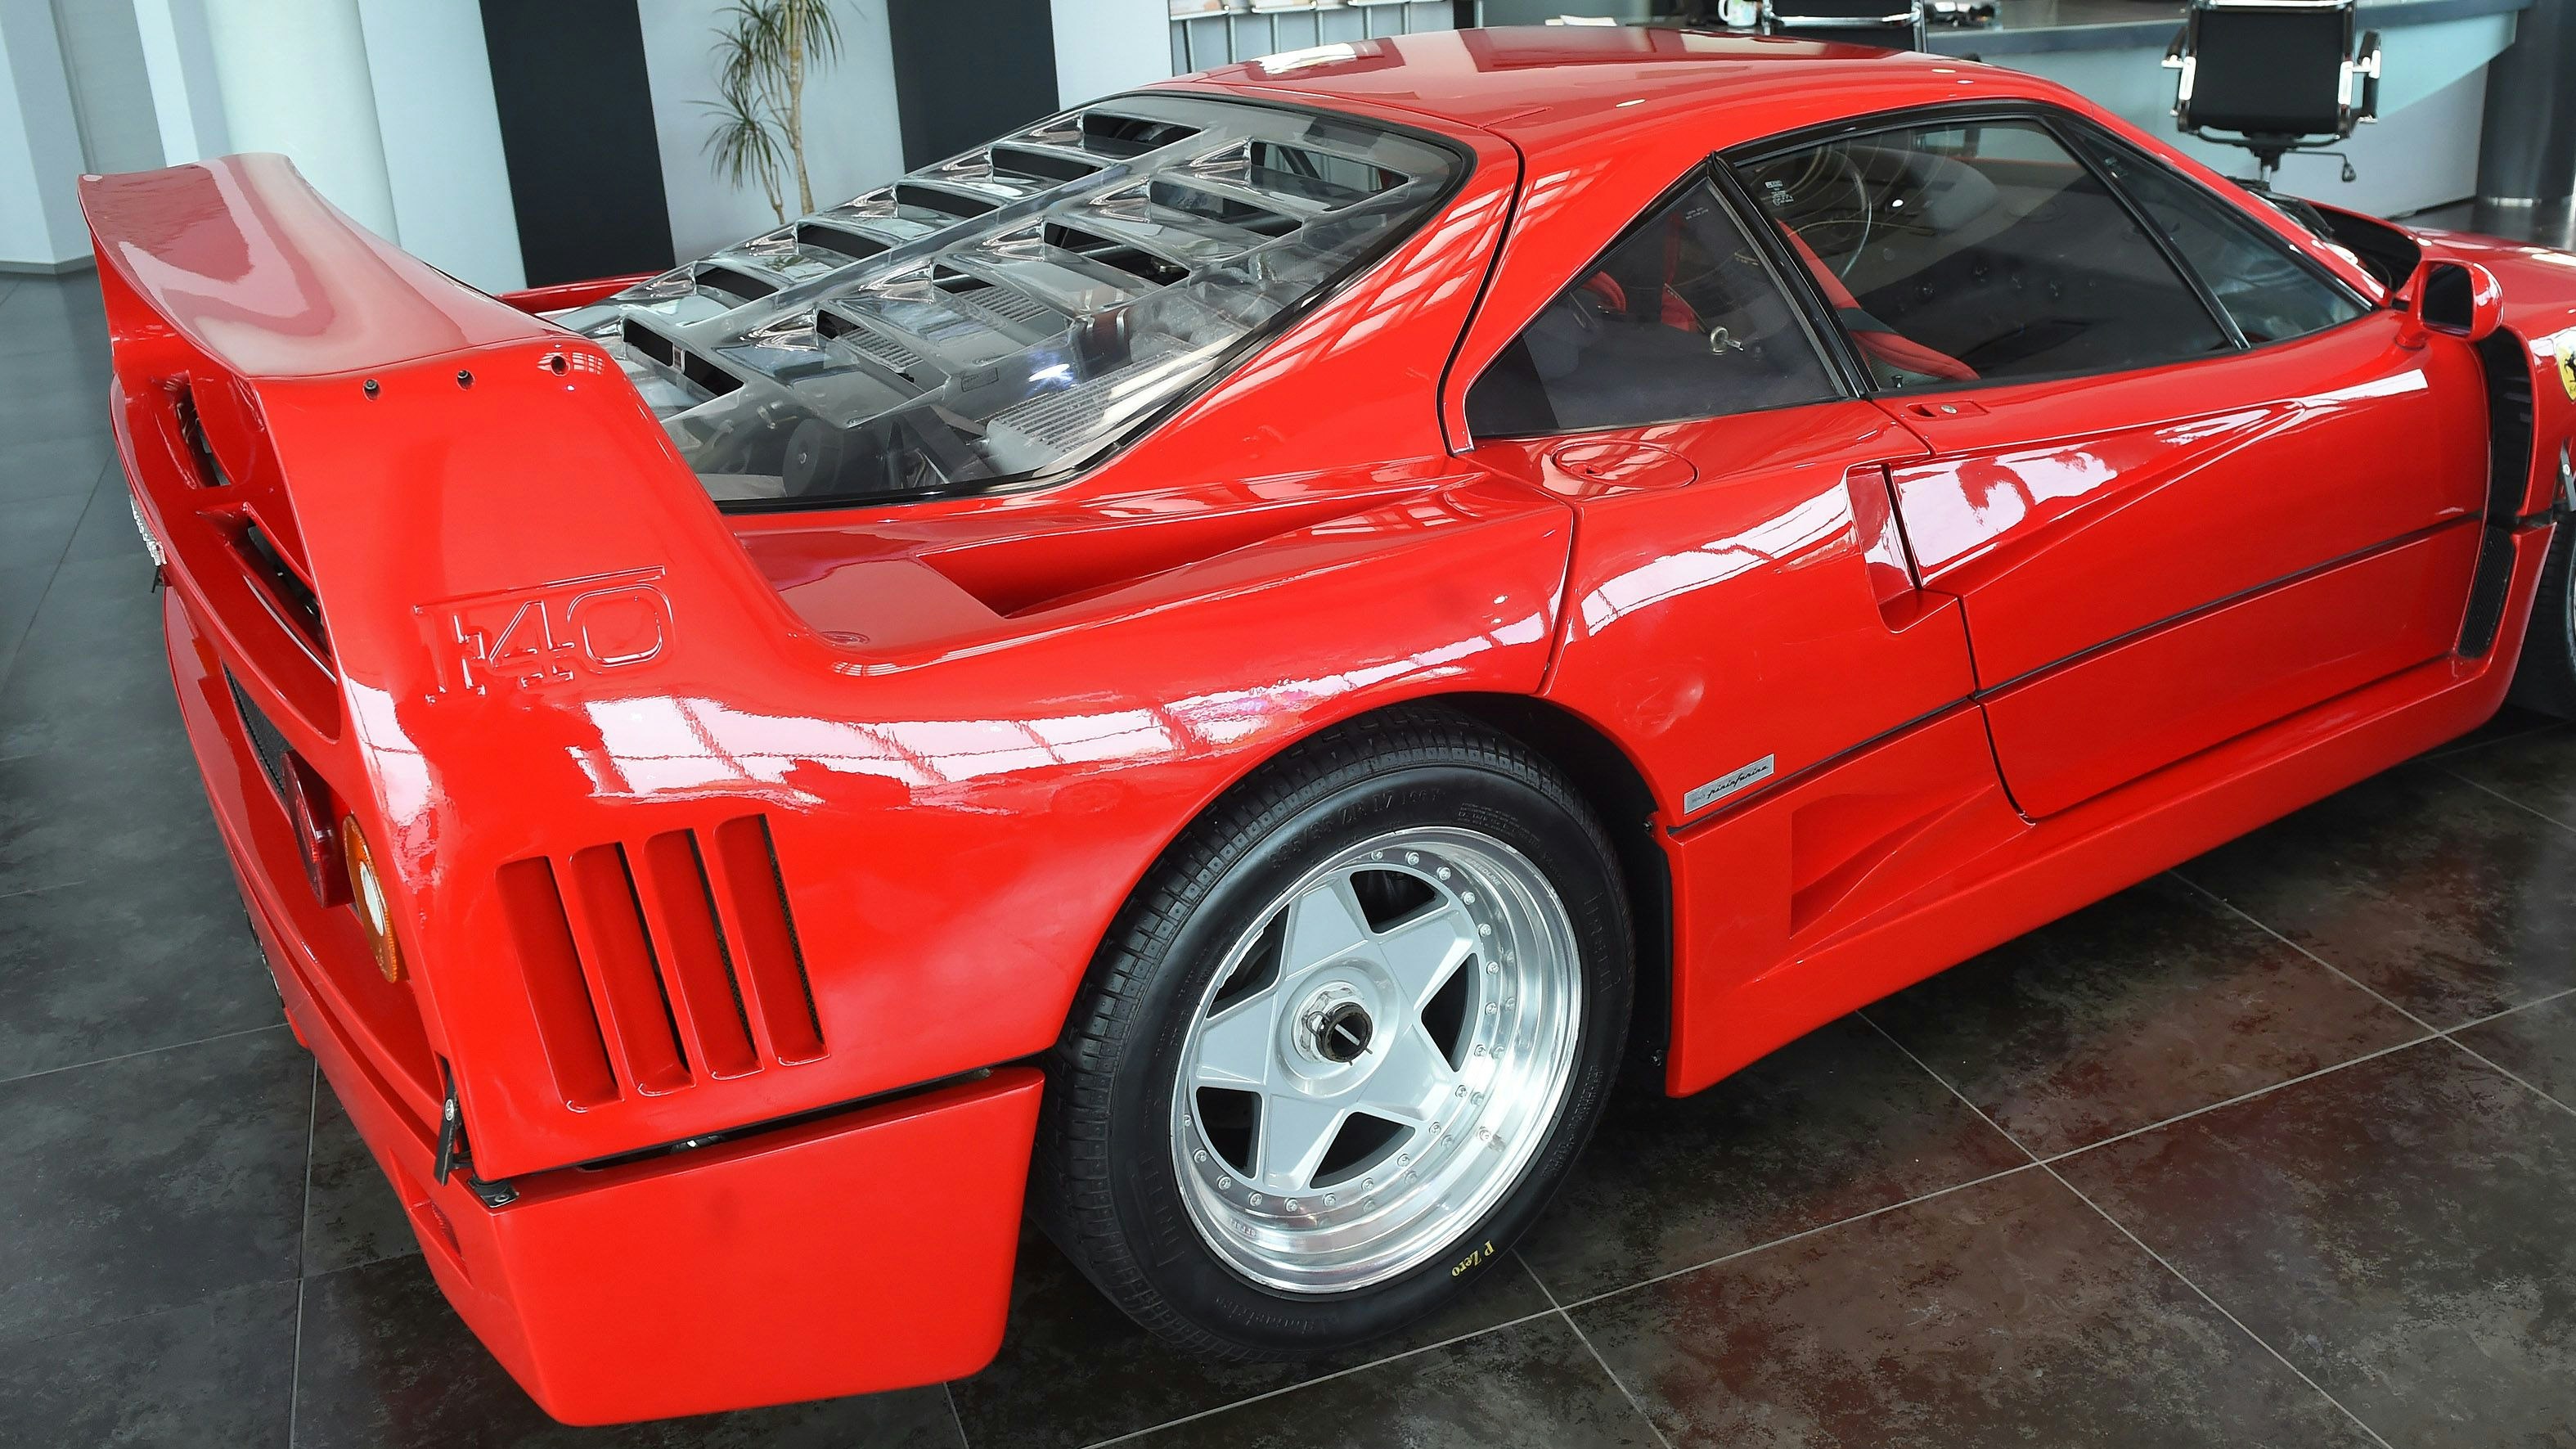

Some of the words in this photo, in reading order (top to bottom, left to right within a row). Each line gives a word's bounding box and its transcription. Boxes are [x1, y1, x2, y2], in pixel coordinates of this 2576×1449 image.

[413, 565, 678, 704] F40
[1484, 1240, 1495, 1257] P
[1450, 1250, 1482, 1277] Zero
